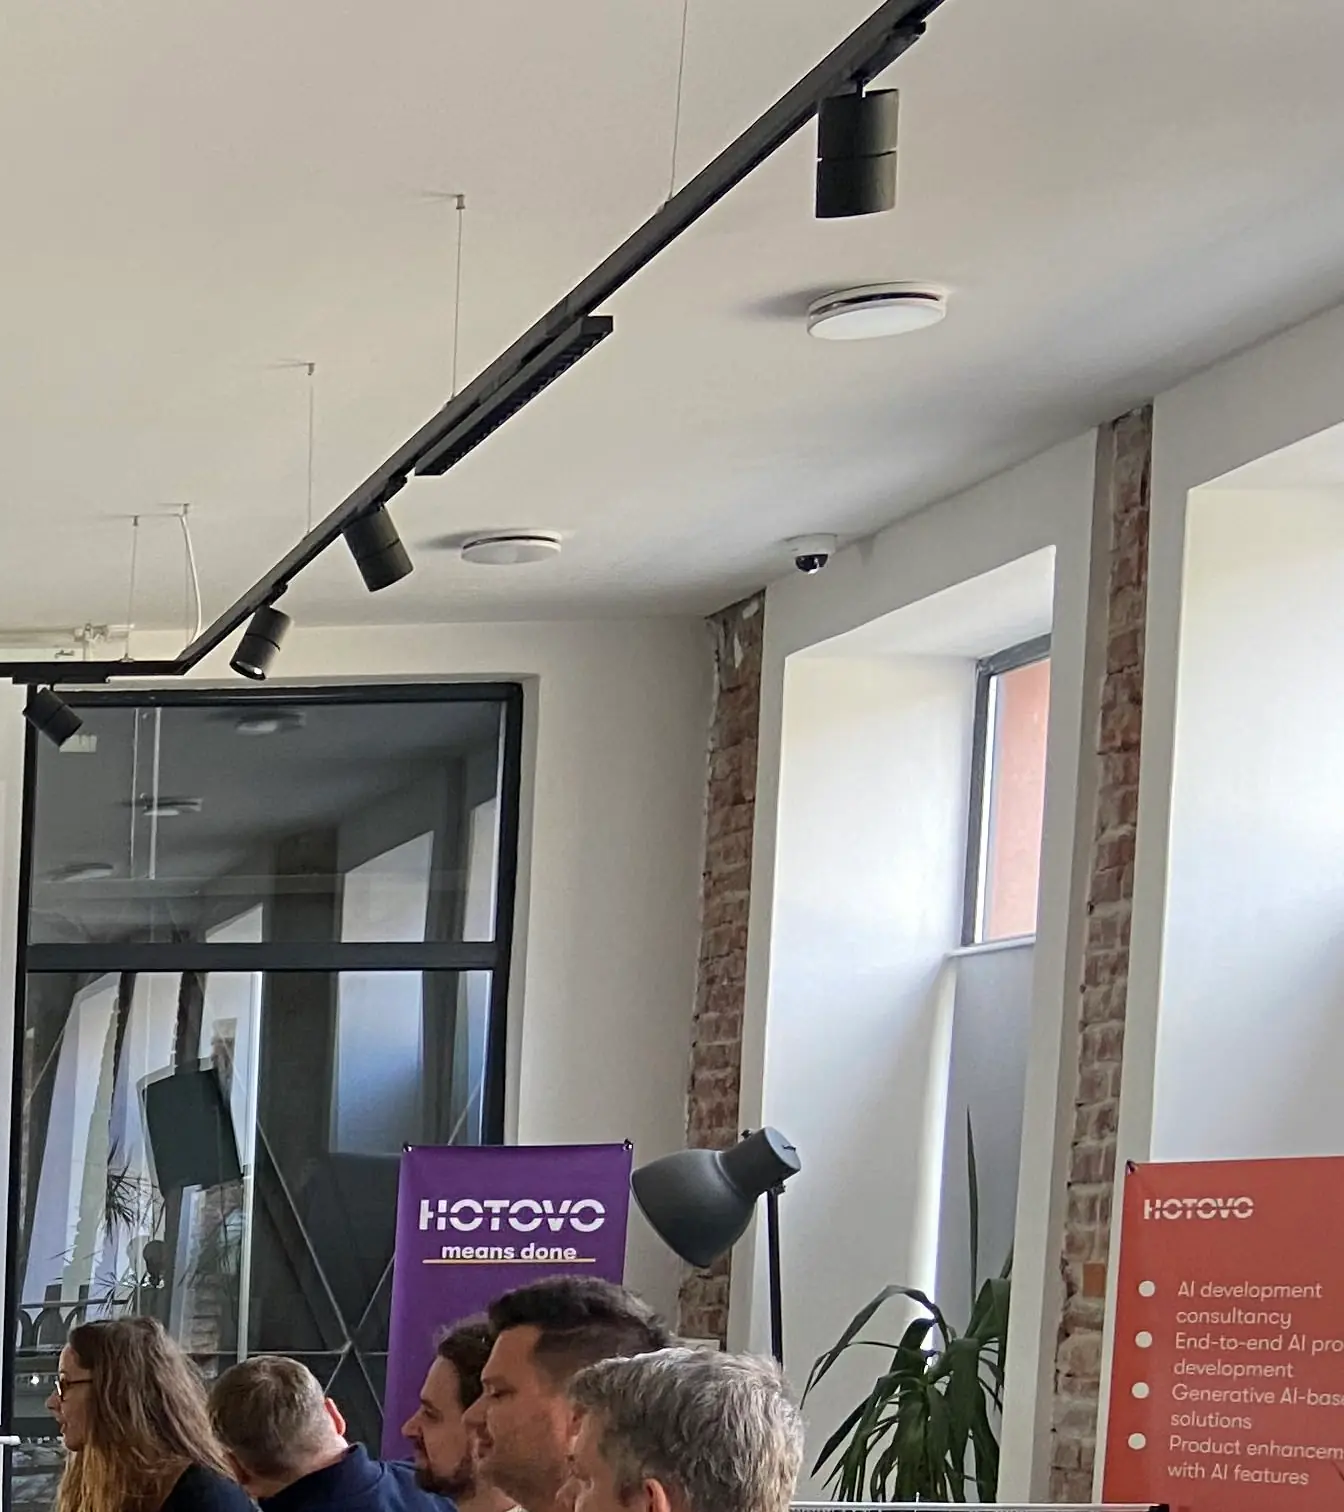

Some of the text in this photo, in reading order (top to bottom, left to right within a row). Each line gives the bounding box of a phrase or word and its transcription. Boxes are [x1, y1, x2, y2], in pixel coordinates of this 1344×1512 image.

[419, 1199, 606, 1232] HOTOVO
[1143, 1197, 1255, 1220] HOTOVO
[442, 1243, 577, 1260] means done
[1178, 1281, 1323, 1301] AI development
[1176, 1306, 1292, 1330] consultancy
[1175, 1332, 1283, 1351] End-to-end
[1288, 1334, 1306, 1351] AI
[1173, 1358, 1295, 1381] development
[1172, 1383, 1344, 1406] Generative AI-bas
[1170, 1411, 1253, 1429] solutions
[1169, 1434, 1241, 1455] Product
[1167, 1461, 1309, 1485] with AI features
